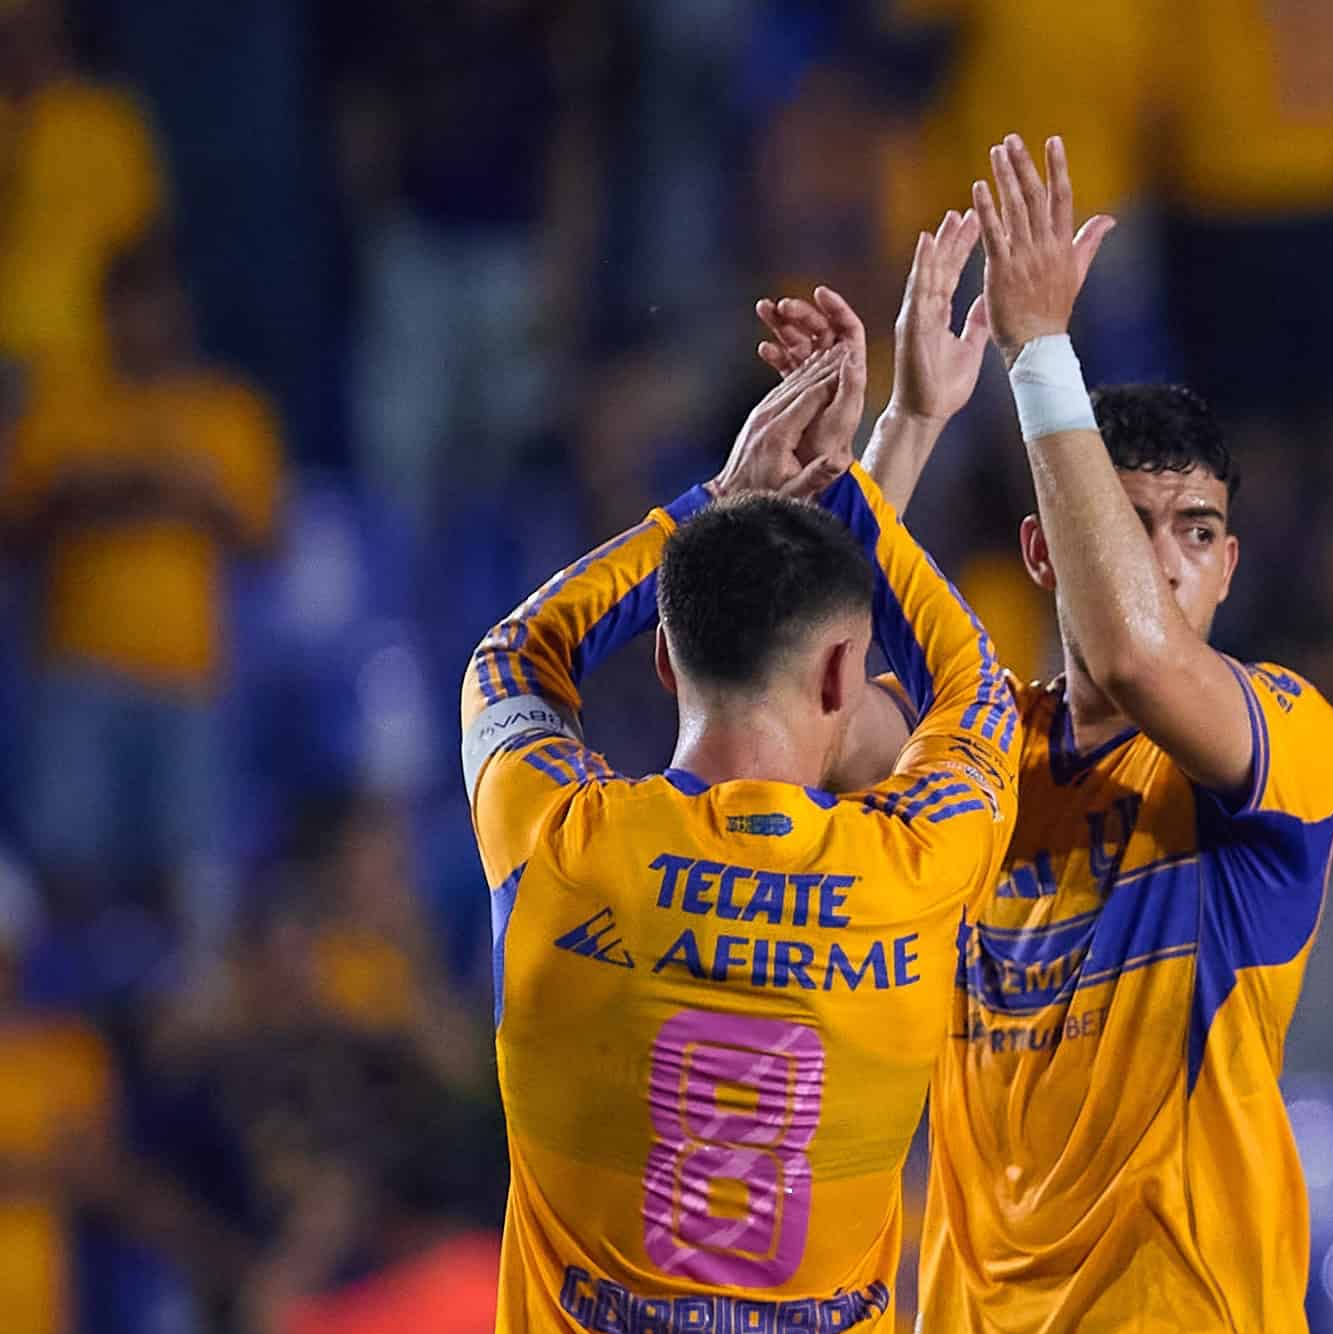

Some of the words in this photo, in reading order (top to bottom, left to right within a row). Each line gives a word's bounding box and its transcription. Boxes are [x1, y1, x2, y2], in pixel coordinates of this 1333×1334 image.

[649, 853, 856, 928] TECATE
[652, 929, 921, 993] AFIRME
[641, 1008, 826, 1289] 8
